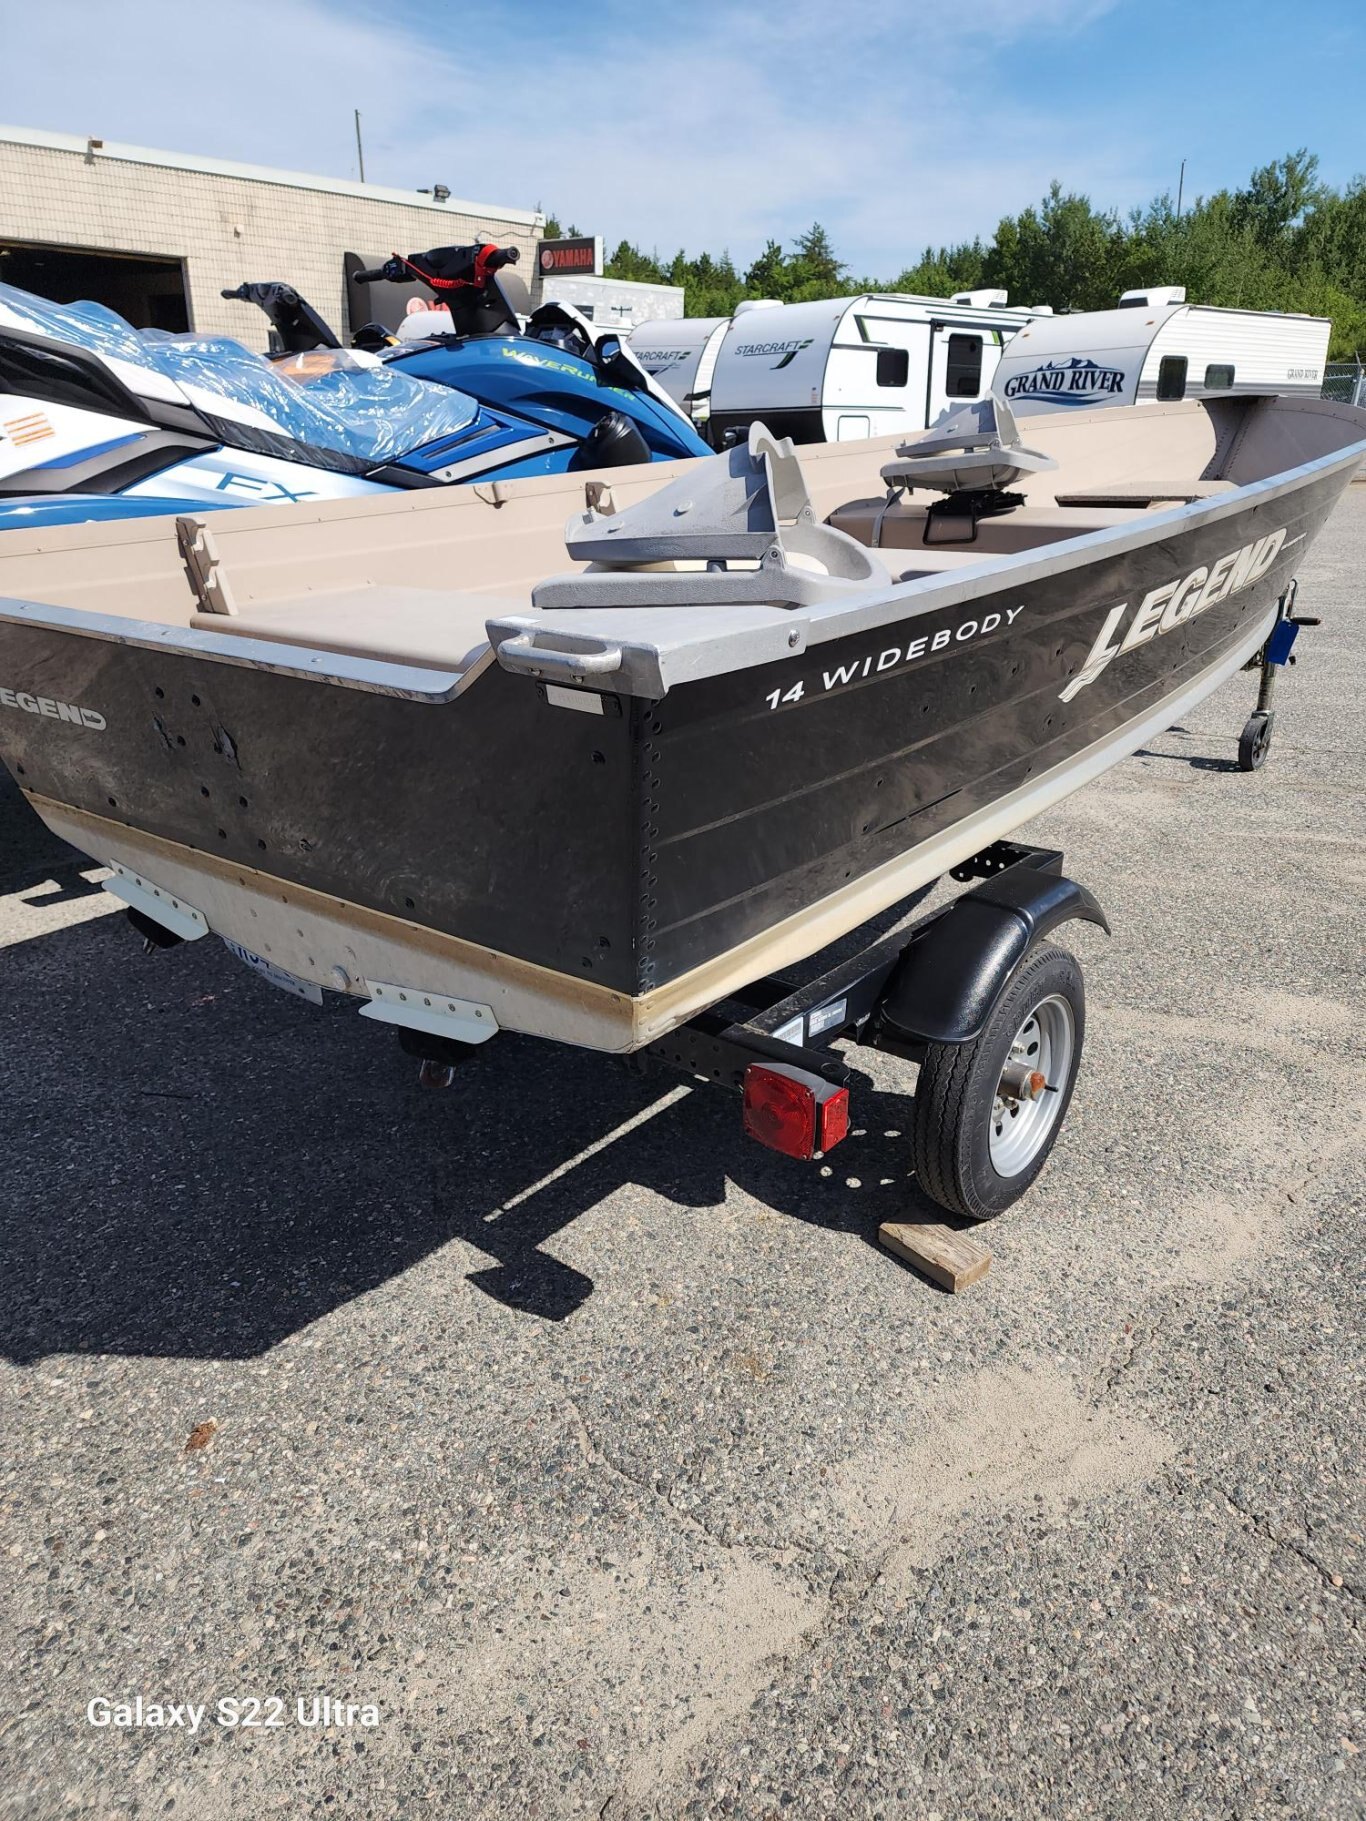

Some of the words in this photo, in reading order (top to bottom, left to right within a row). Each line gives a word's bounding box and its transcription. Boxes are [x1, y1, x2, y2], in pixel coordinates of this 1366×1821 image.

[553, 248, 593, 267] YAMAHA
[633, 351, 681, 361] TARCRAFT
[734, 340, 802, 355] STARCRAFT
[1004, 372, 1065, 397] GRAND
[1067, 370, 1125, 393] RIVER
[215, 472, 319, 503] FX
[1059, 528, 1287, 702] LEGEND
[766, 681, 805, 709] 14
[822, 606, 1025, 690] WIDEBODY
[0, 687, 107, 731] EGEND
